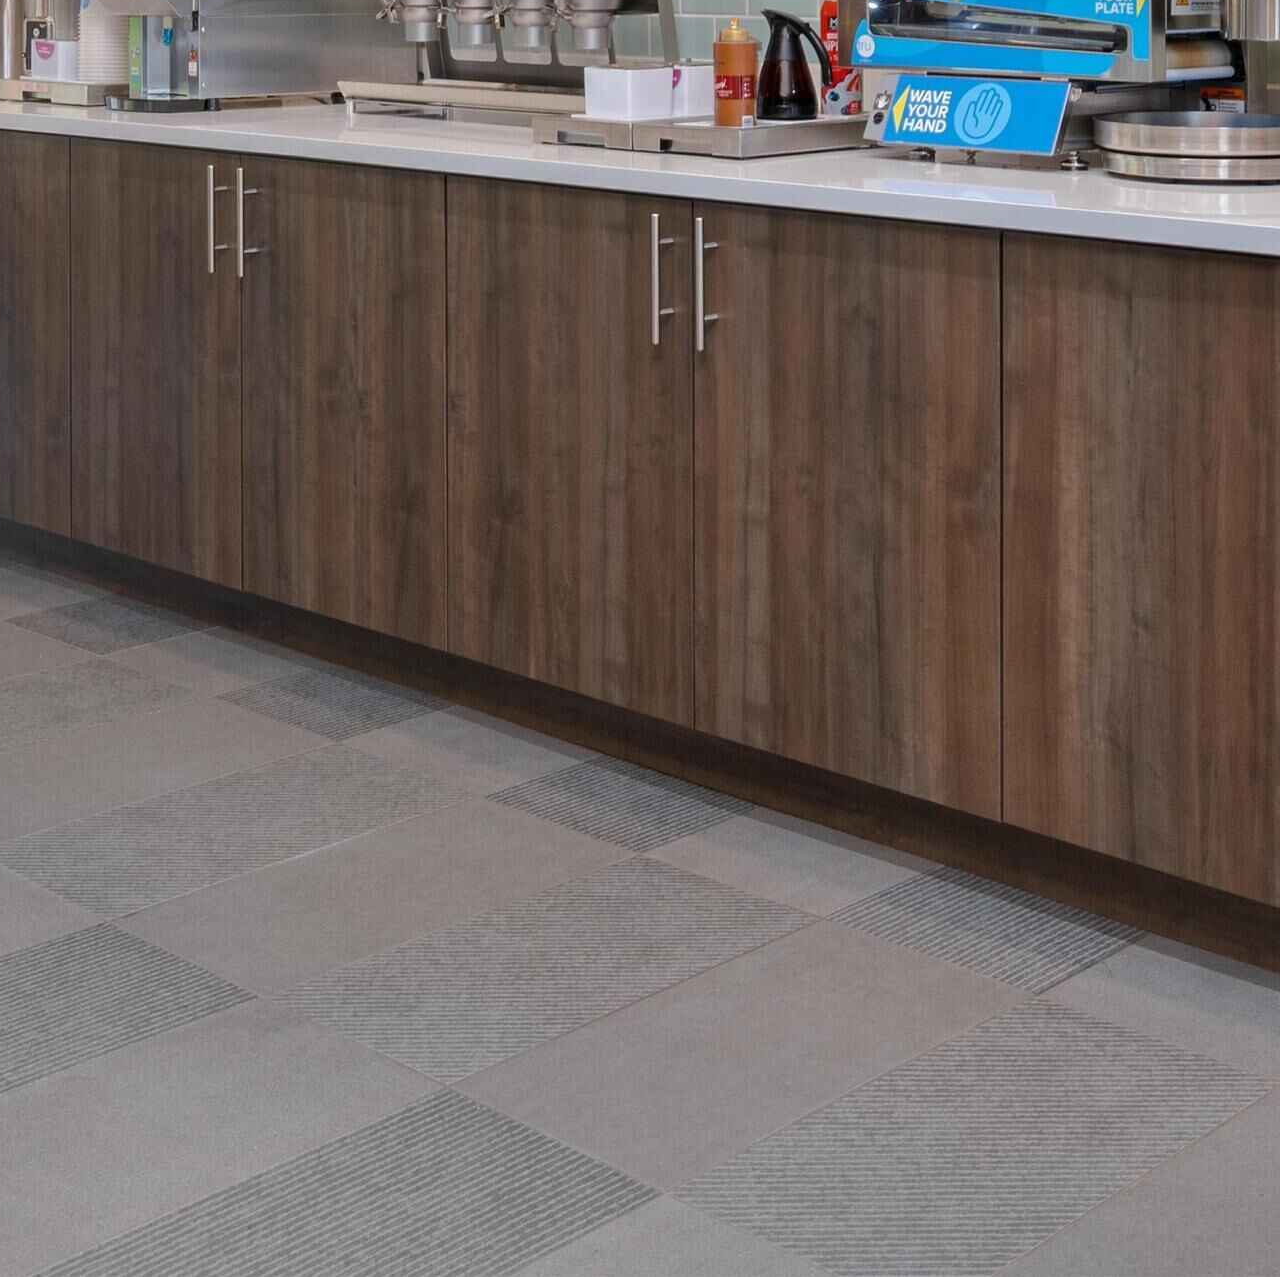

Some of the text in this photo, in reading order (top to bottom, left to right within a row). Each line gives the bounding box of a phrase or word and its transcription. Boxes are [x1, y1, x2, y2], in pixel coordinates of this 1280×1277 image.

[1095, 3, 1134, 14] PLATE
[910, 89, 952, 104] WAVE
[908, 104, 949, 118] YOUR
[902, 118, 947, 133] HAND
